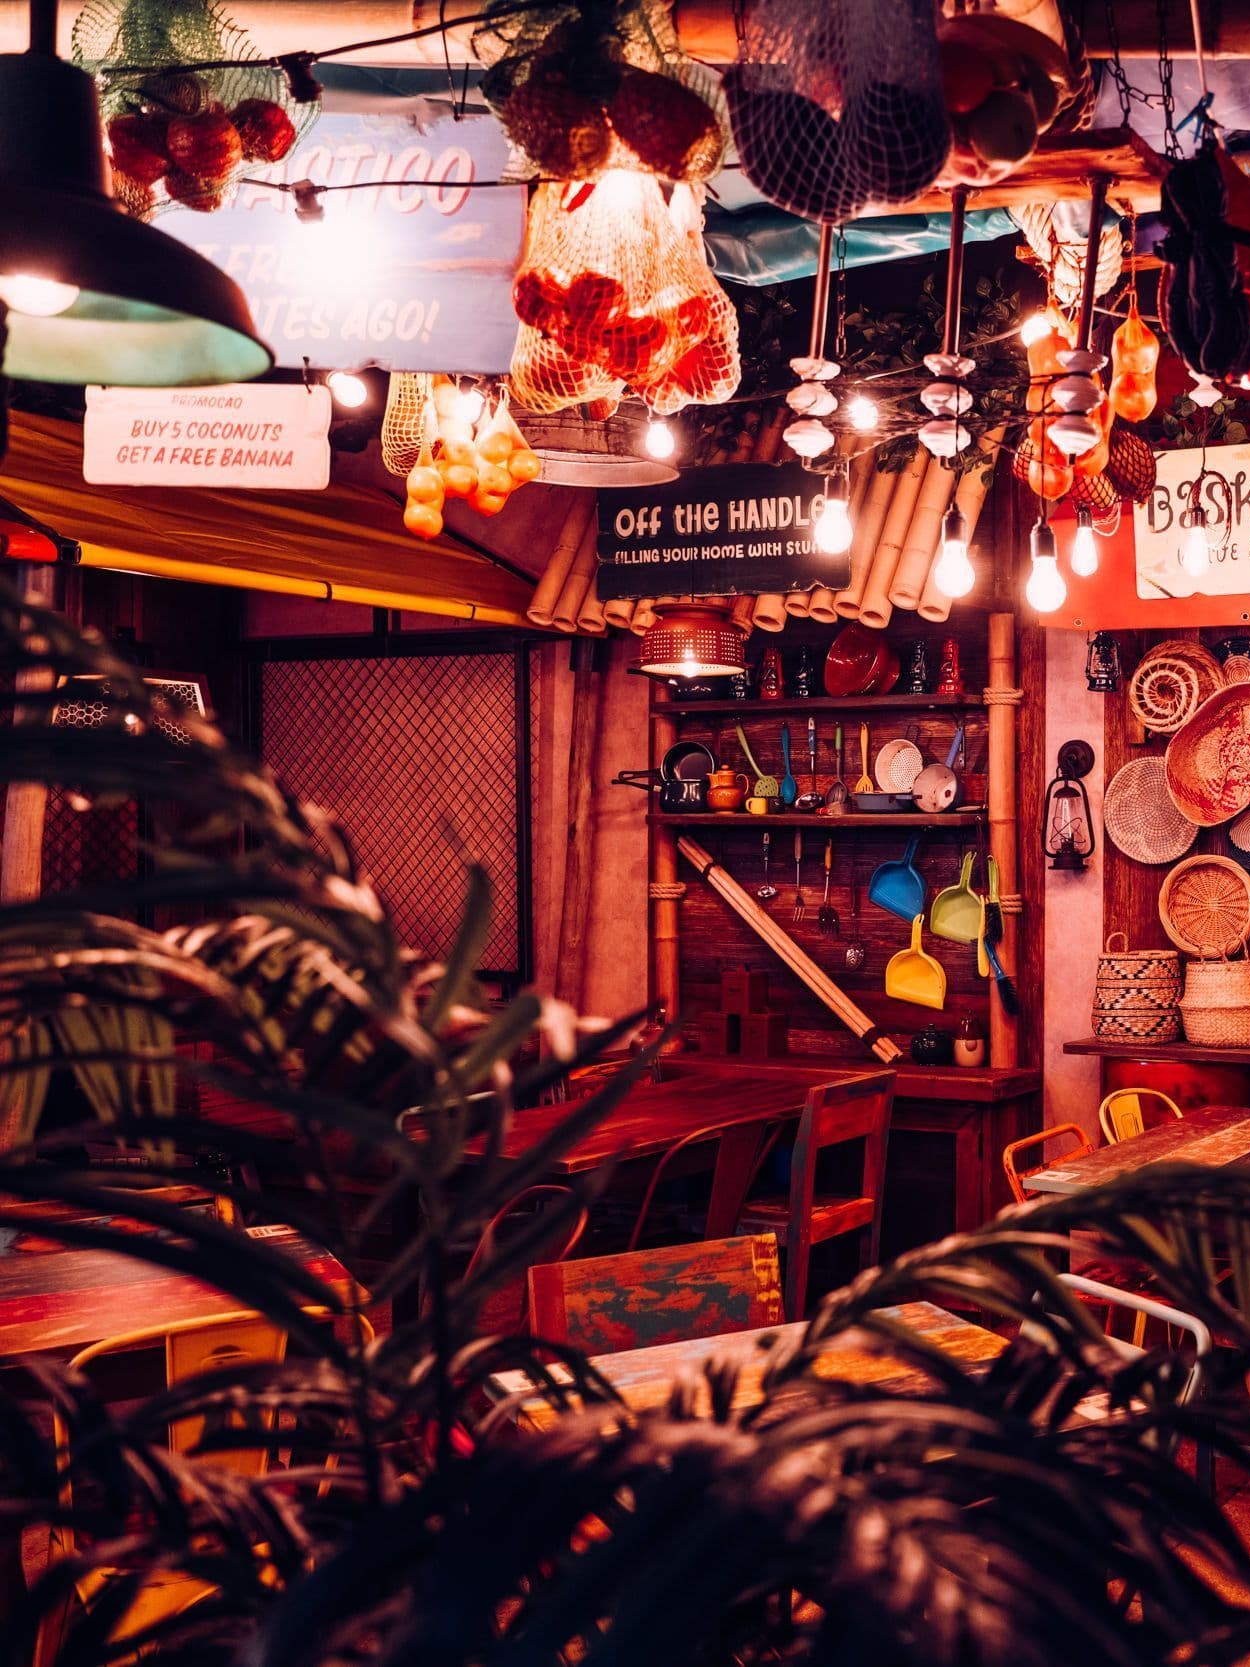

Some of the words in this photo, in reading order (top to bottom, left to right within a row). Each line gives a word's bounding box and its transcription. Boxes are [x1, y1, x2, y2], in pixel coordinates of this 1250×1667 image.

[340, 297, 440, 343] AGO!
[131, 420, 168, 438] BUY
[171, 423, 181, 438] 5
[186, 422, 283, 442] COCONUTS
[117, 445, 149, 464] GET
[154, 447, 167, 464] A
[170, 447, 216, 466] FREE
[220, 449, 294, 467] BANANA
